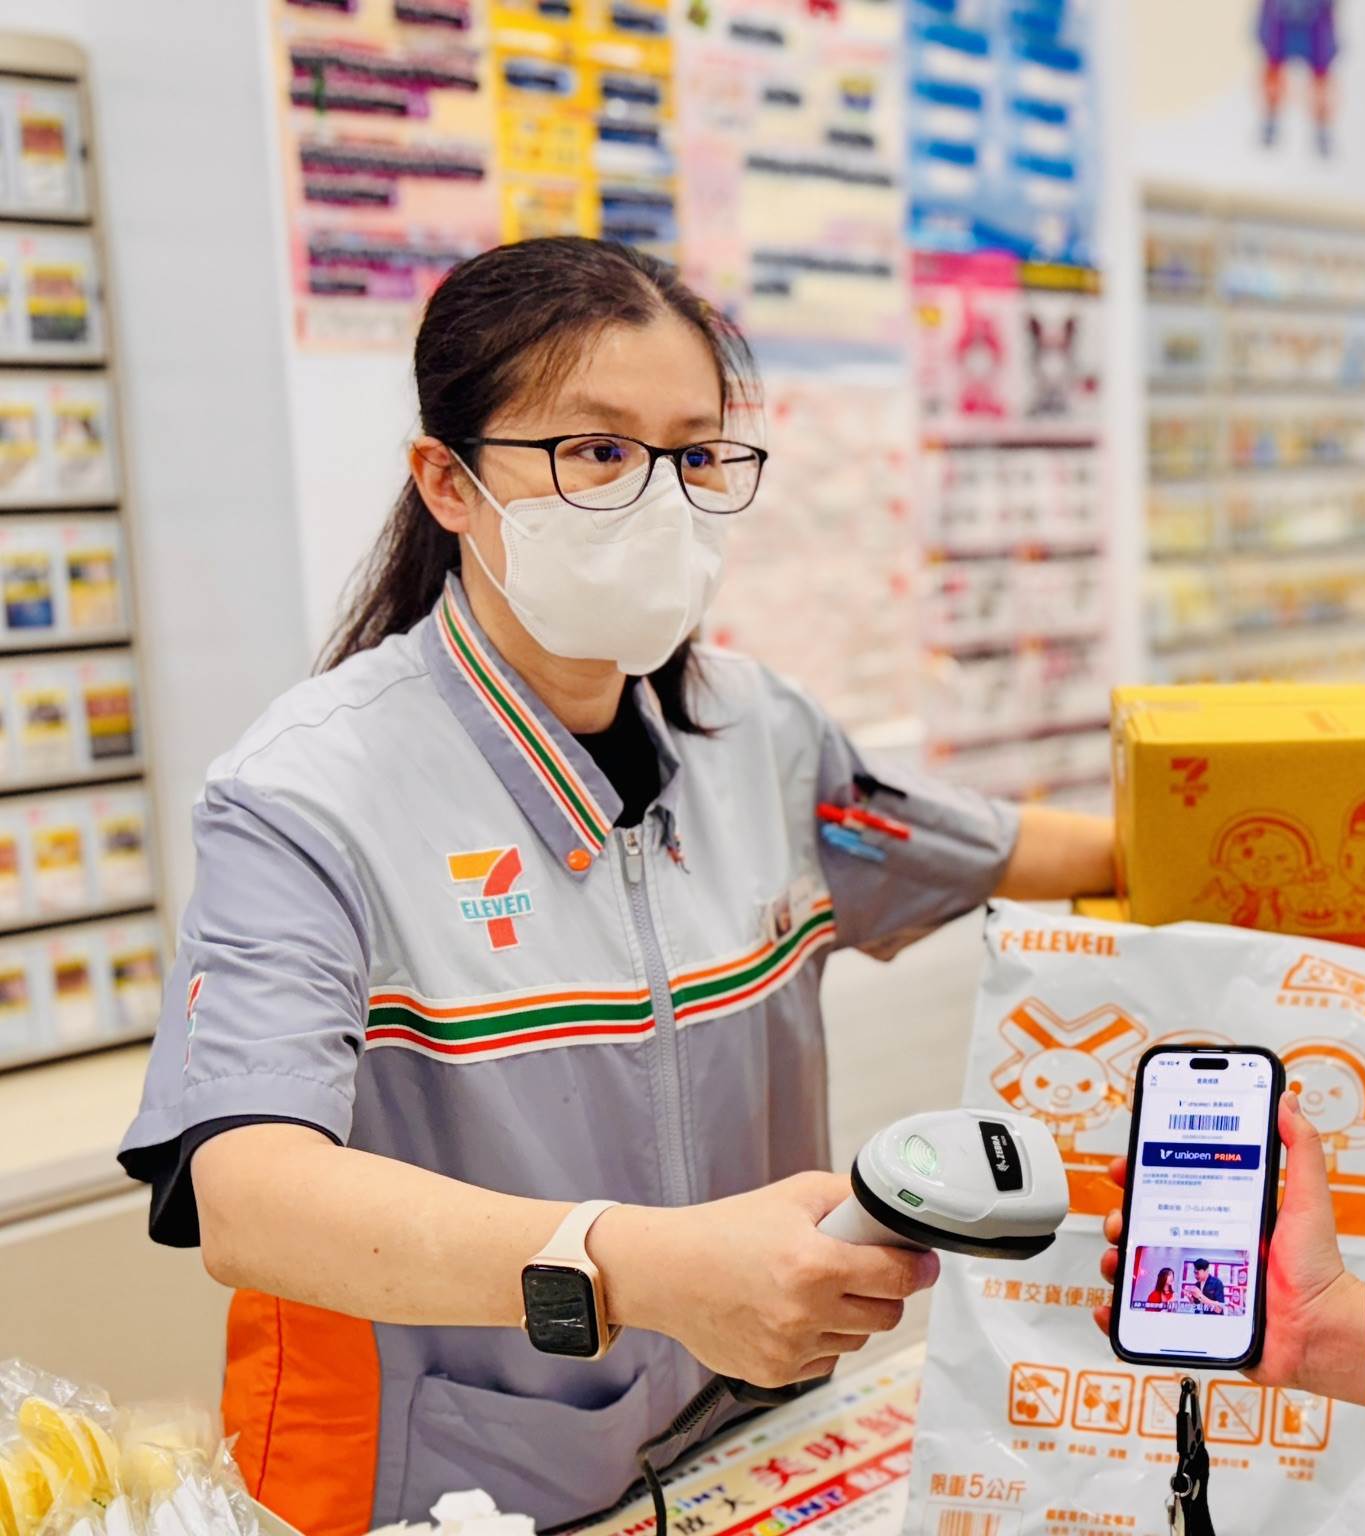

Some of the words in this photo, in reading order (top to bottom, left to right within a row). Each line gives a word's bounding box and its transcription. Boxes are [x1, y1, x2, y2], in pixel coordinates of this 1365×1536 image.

[446, 845, 524, 951] 7
[991, 1135, 1005, 1159] ZEBRA
[1214, 1152, 1242, 1162] PRIMA
